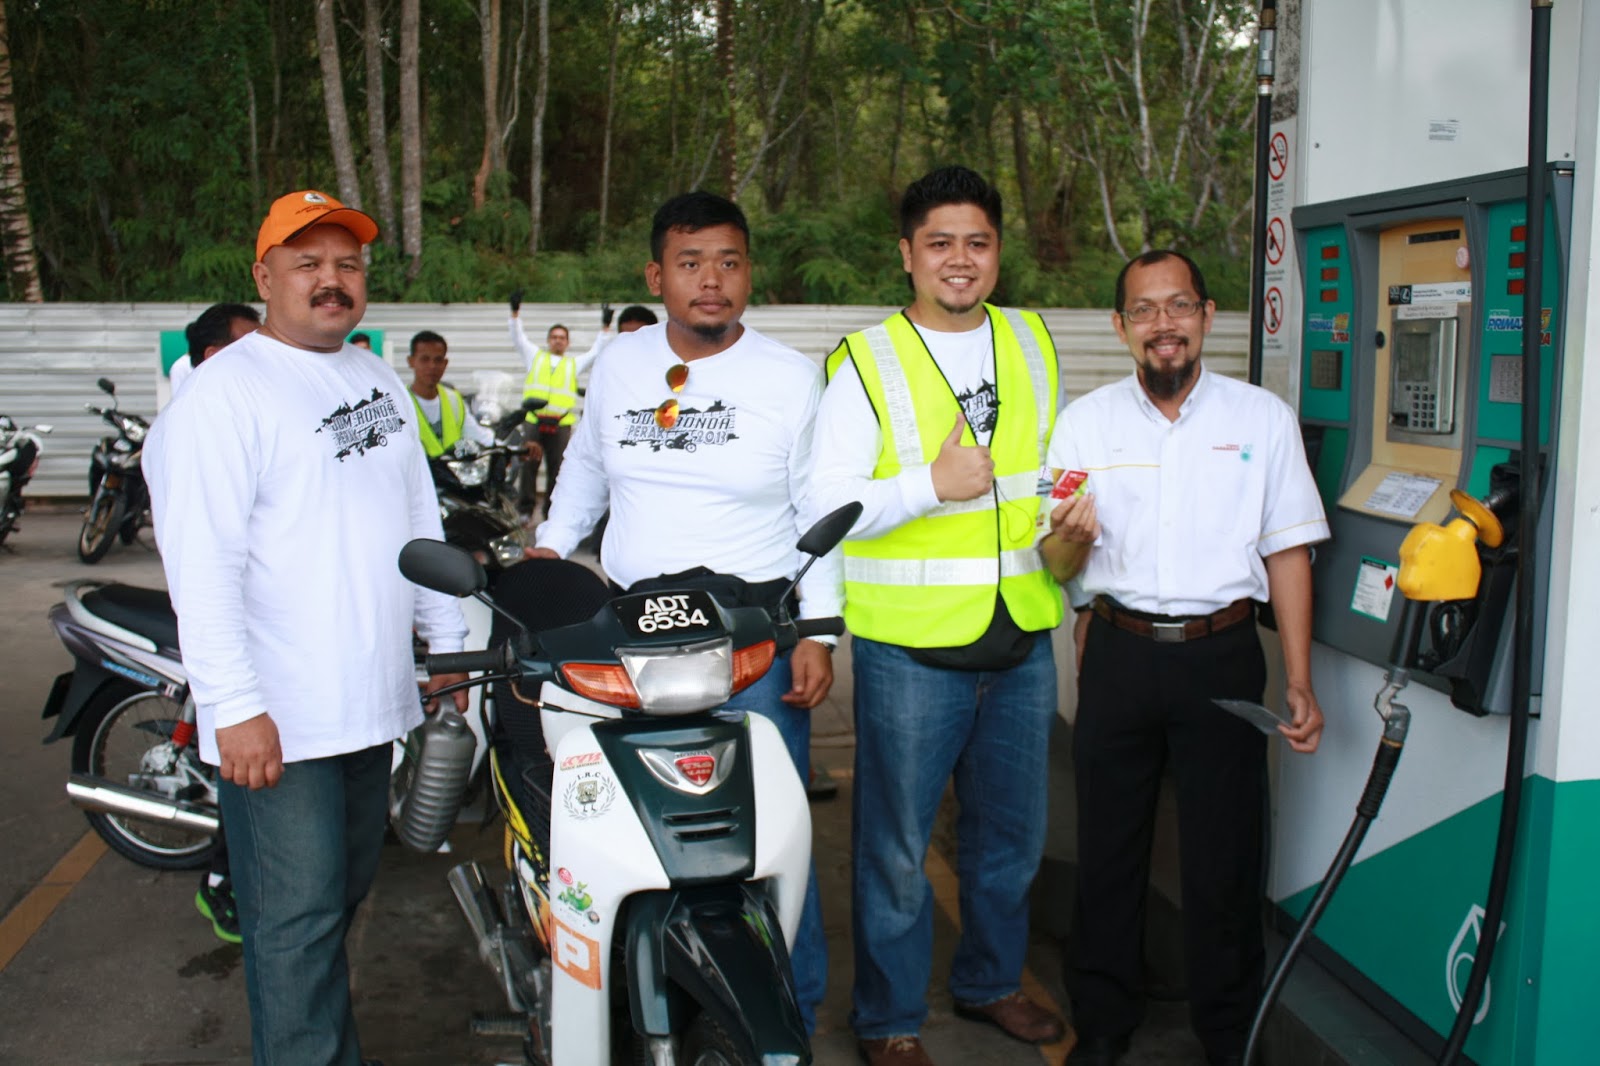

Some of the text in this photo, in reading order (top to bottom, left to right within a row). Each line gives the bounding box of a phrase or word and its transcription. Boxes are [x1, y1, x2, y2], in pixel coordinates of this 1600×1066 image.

[331, 404, 396, 432] JOM RONDA
[627, 426, 665, 440] PERAK
[645, 595, 689, 615] ADT
[638, 608, 709, 633] 6534
[556, 925, 590, 971] P
